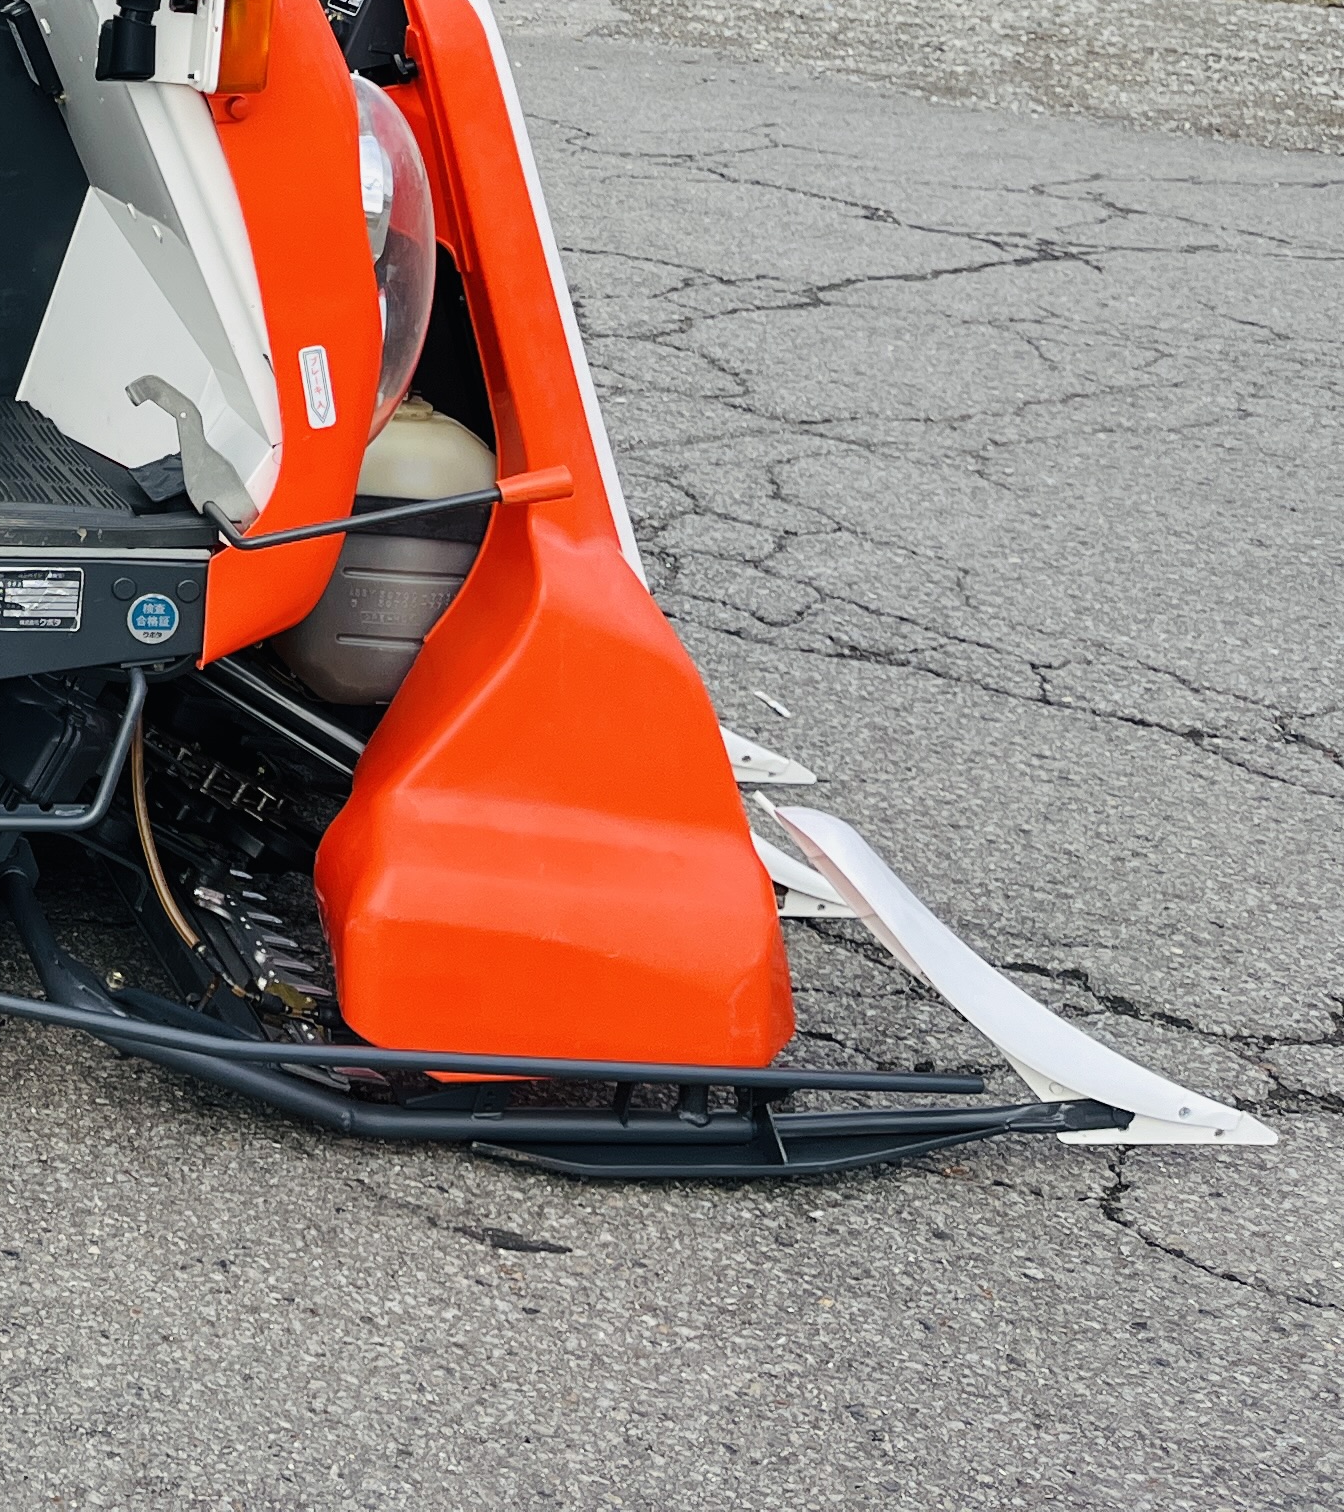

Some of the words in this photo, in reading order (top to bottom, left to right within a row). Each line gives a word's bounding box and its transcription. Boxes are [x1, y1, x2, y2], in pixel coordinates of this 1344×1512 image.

[143, 603, 166, 614] 検査
[136, 615, 170, 627] 合格証
